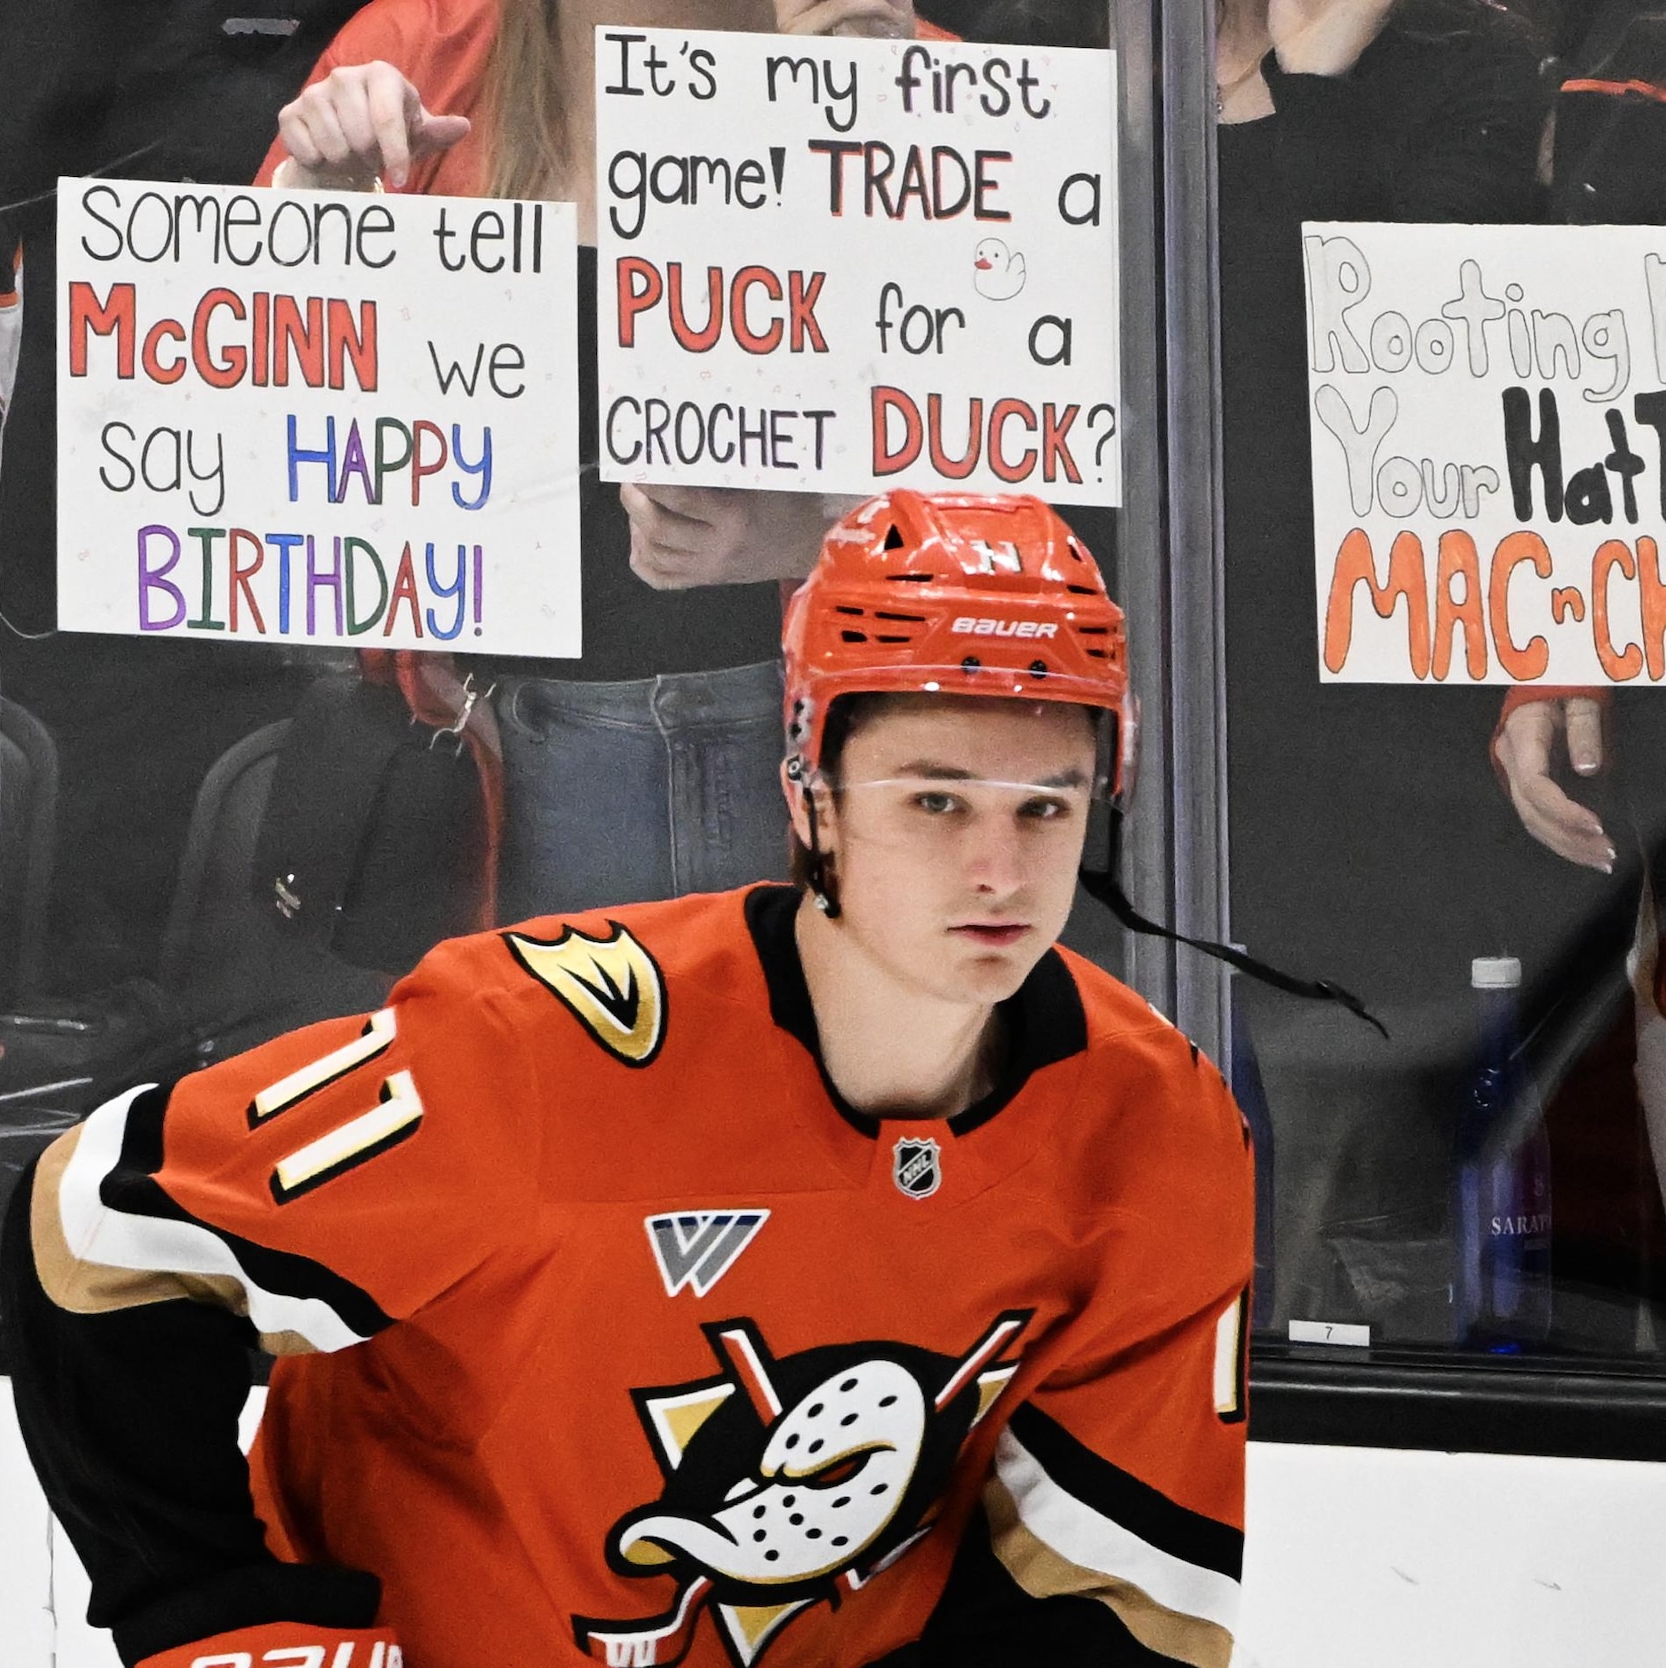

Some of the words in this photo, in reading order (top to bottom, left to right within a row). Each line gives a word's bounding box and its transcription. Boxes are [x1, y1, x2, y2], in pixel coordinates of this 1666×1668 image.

[604, 33, 717, 100] It's
[767, 54, 857, 133] my
[895, 45, 1051, 120] first
[433, 202, 542, 274] tell
[608, 147, 786, 240] game!
[809, 139, 1013, 222] TRADE
[1057, 171, 1102, 226] a
[69, 281, 378, 392] McGINN
[428, 340, 526, 399] we
[615, 256, 830, 355] PUCK
[875, 282, 966, 355] for
[1028, 313, 1072, 367] a
[1304, 235, 1630, 403] Rooting
[99, 421, 225, 517] say
[606, 395, 837, 471] CROCHET
[871, 386, 1117, 485] DUCK?
[1315, 384, 1500, 518] Your
[137, 525, 484, 641] BIRTHDAY!
[951, 617, 1059, 639] BAUER
[1323, 528, 1552, 681] MAC
[1491, 1214, 1551, 1235] SARAT
